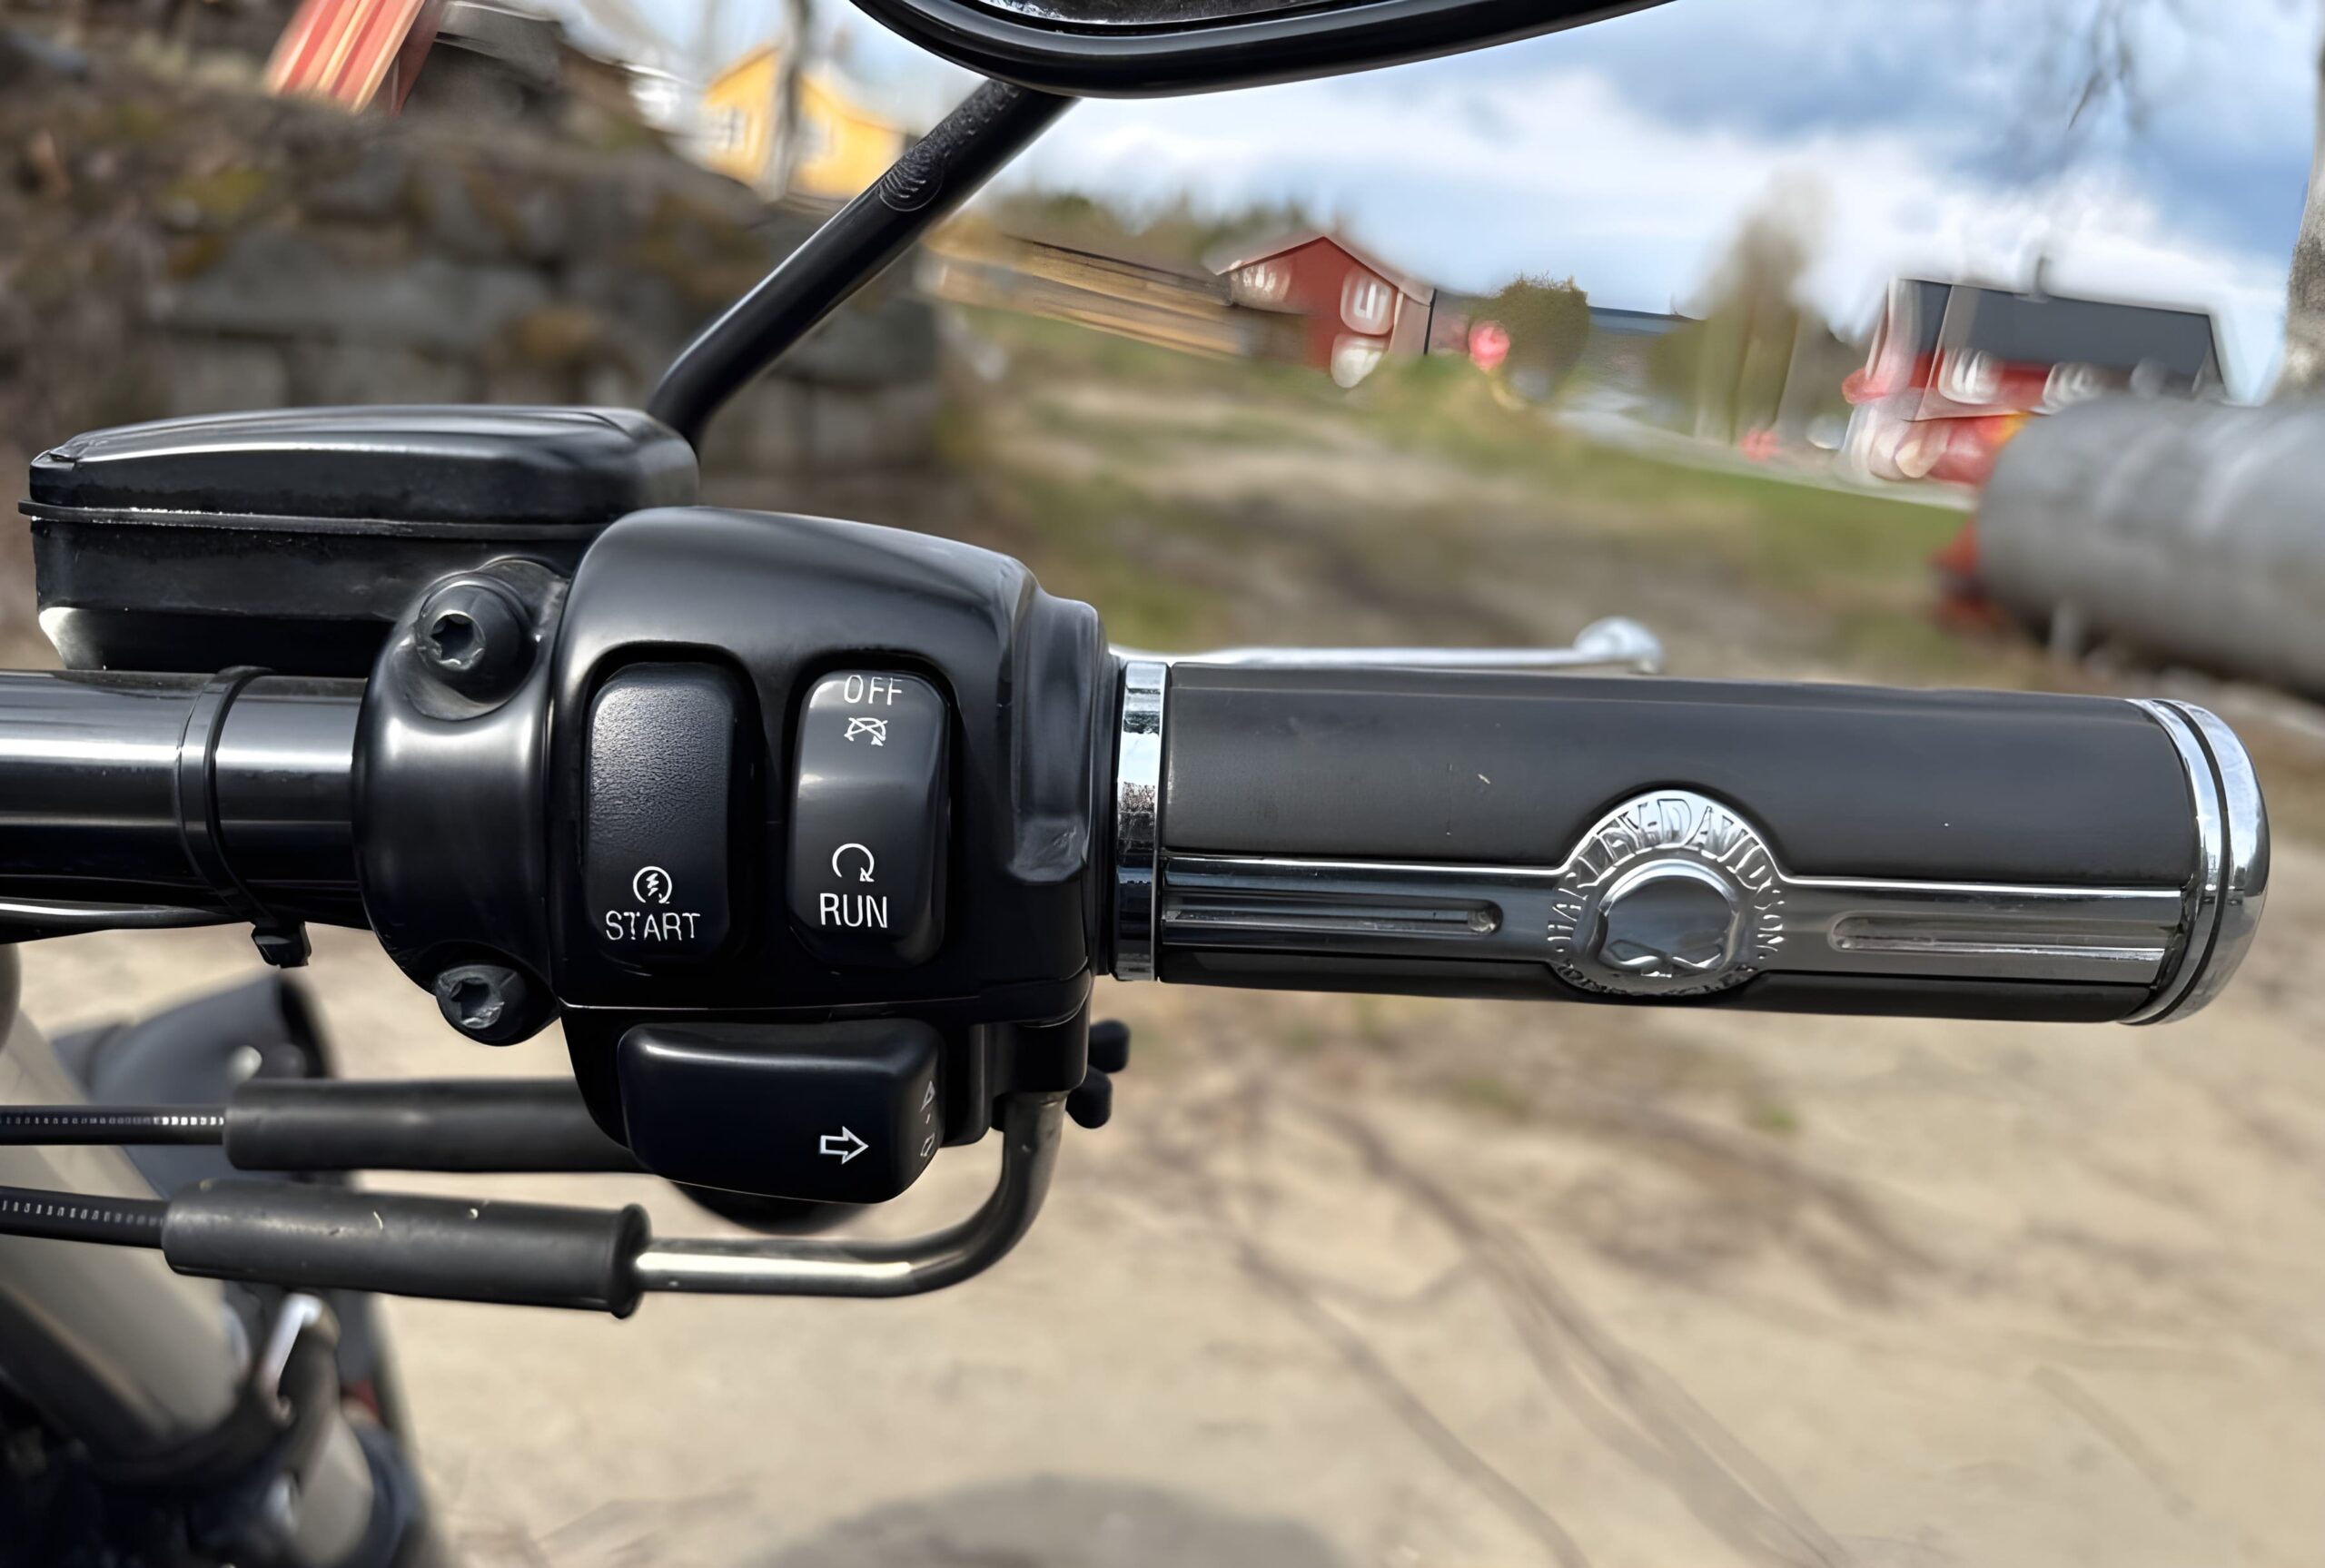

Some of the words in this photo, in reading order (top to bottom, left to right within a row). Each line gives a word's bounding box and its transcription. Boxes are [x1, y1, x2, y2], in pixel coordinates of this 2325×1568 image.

[844, 675, 904, 705] OFF
[820, 892, 888, 929] RUN
[606, 911, 701, 942] START
